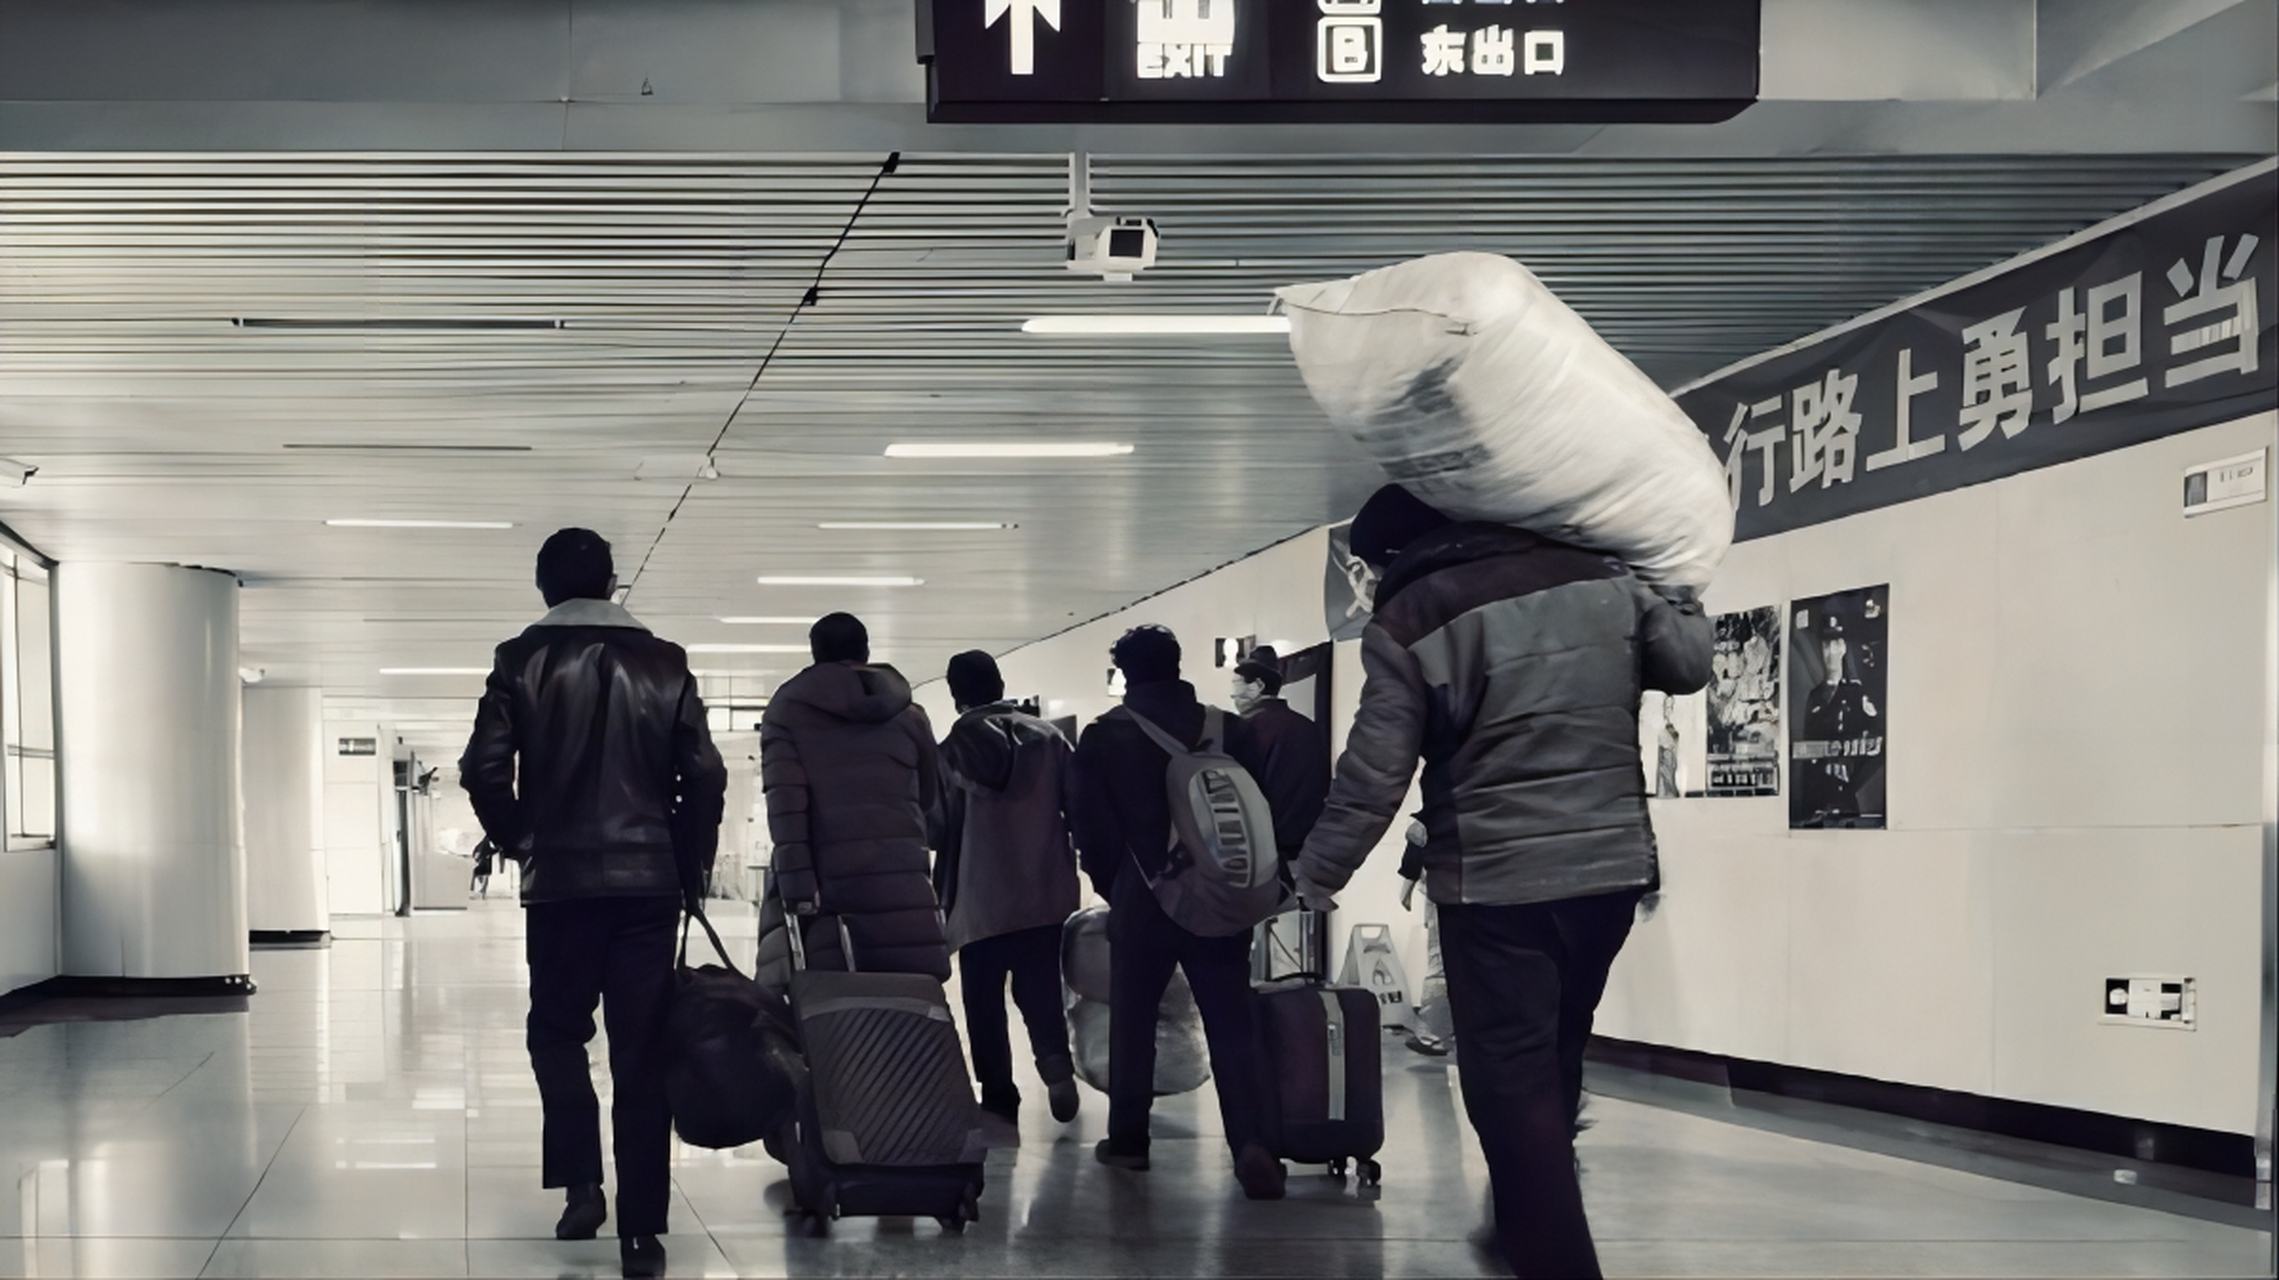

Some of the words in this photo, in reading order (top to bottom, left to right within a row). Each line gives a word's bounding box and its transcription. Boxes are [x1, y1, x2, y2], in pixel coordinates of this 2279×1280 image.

[1137, 43, 1233, 78] EXIT
[1420, 24, 1565, 76] 东出口
[1723, 233, 2260, 512] 行路上勇担当
